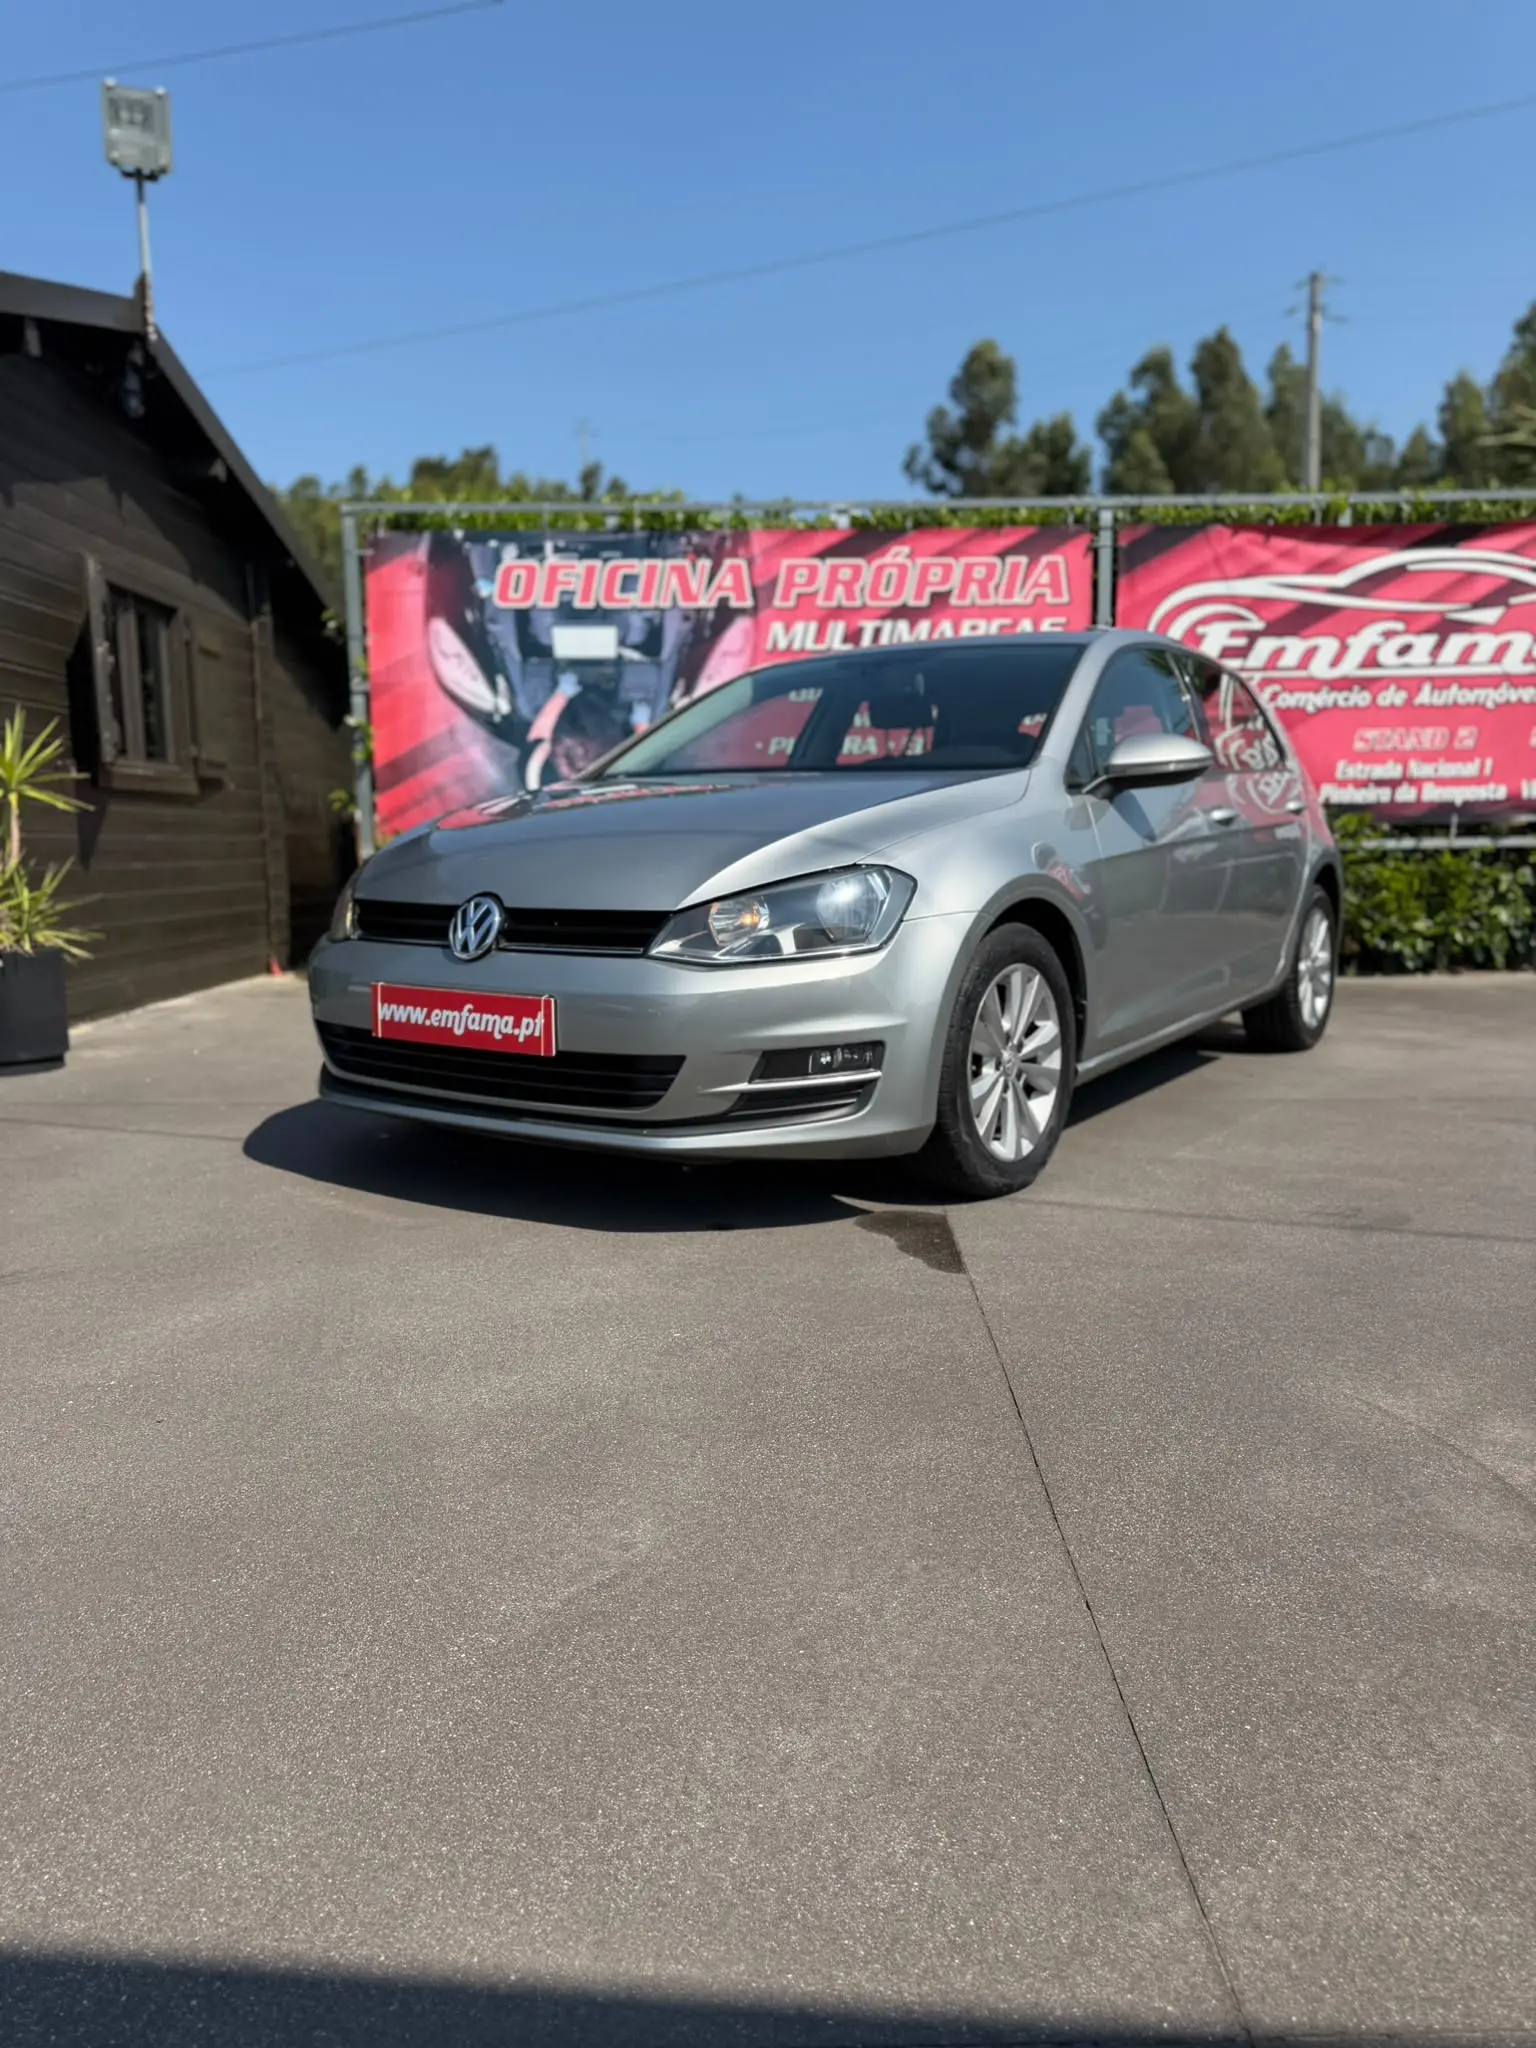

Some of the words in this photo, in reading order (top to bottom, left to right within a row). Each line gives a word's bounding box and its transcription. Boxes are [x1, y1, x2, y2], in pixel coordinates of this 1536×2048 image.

[494, 557, 754, 609] OFICINA
[772, 545, 1071, 609] PRÓPRIA
[1195, 620, 1536, 679] Emfam
[1376, 683, 1409, 708] de
[1412, 680, 1536, 711] Automóve
[379, 1002, 545, 1043] www.emfama.pt
